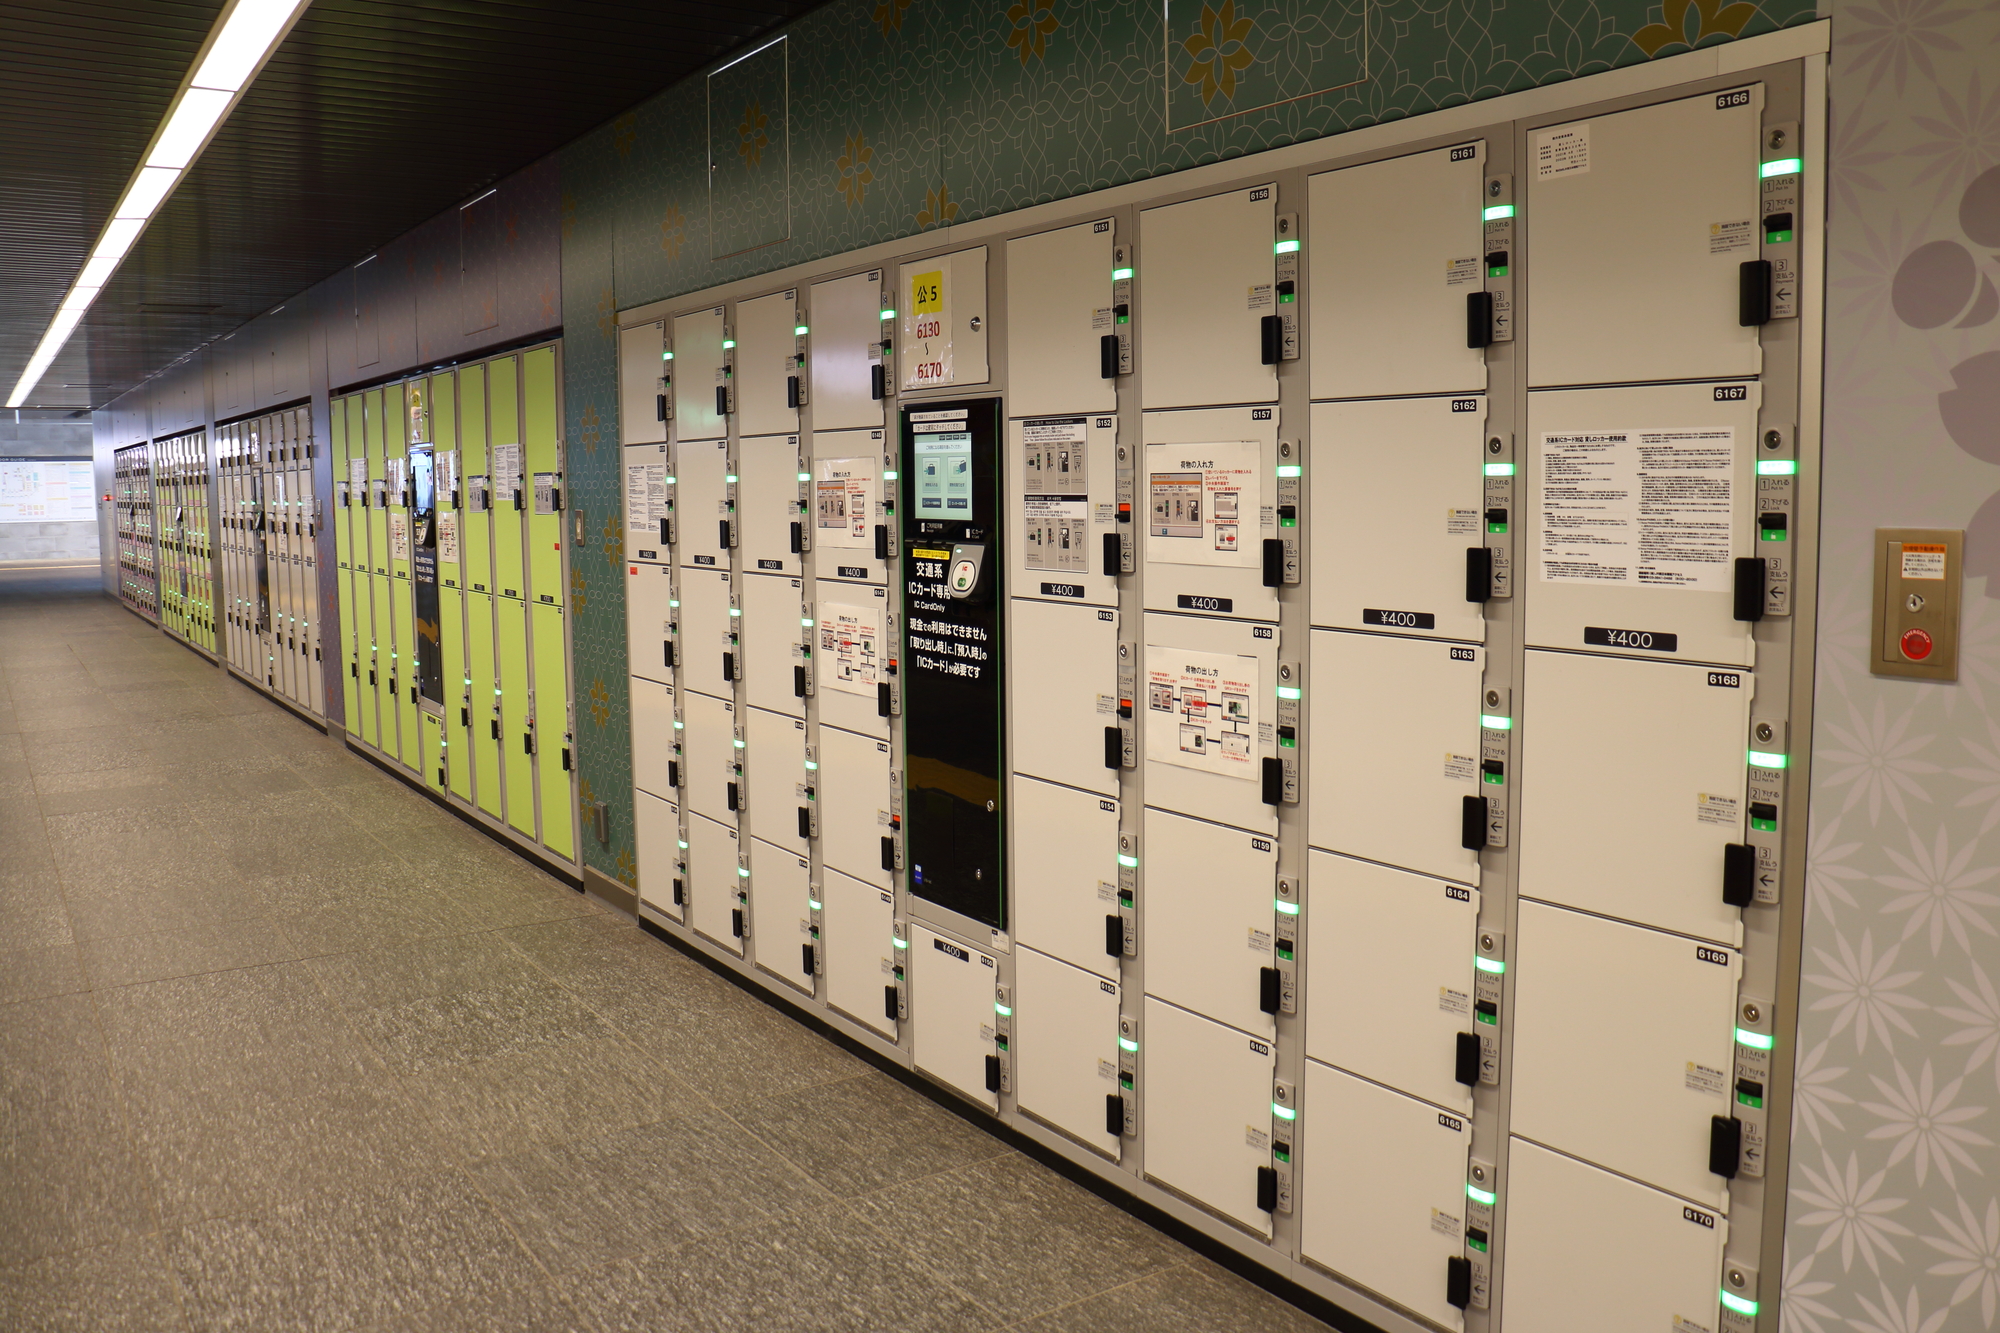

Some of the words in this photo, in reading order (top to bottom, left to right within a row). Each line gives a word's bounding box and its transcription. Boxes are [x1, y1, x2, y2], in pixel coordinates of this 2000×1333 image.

[1718, 92, 1748, 107] 6166
[1452, 148, 1473, 159] 6161
[1775, 178, 1795, 186] 入れる
[1250, 190, 1268, 200] 6156
[1094, 223, 1108, 232] 6151
[1776, 271, 1795, 279] 支払う
[917, 286, 928, 304] 公
[931, 286, 937, 301] 5
[917, 321, 940, 338] 6130
[917, 362, 942, 379] 6170
[1716, 388, 1744, 398] 6167
[1453, 402, 1475, 410] 6162
[1253, 411, 1270, 419] 6157
[1180, 460, 1214, 469] 荷物の入れ方
[845, 568, 860, 577] ¥400
[916, 562, 943, 578] 交通系
[908, 581, 950, 600] ICカード専用
[1051, 585, 1073, 596] ¥400
[1191, 597, 1218, 610] ¥400
[1098, 612, 1112, 621] 6153
[1381, 611, 1415, 626] ¥400
[909, 618, 987, 641] 現金での利用はできません
[1254, 629, 1271, 637] 6158
[1608, 630, 1652, 648] ¥400
[1904, 629, 1930, 643] EMERGENCY
[1452, 650, 1473, 659] 6163
[917, 655, 981, 679] 「ICカード」が必要です
[1185, 665, 1218, 677] 荷物の出し方
[1710, 674, 1738, 686] 6168
[1762, 770, 1780, 779] 入れる
[1761, 790, 1780, 799] 下げる
[1100, 802, 1114, 811] 6154
[1253, 840, 1270, 851] 6159
[1447, 888, 1468, 900] 6164
[943, 944, 960, 958] ¥400
[1698, 950, 1726, 963] 6169
[1250, 1041, 1268, 1055] 6160
[1749, 1050, 1766, 1059] 入れる
[1748, 1068, 1765, 1077] 下げる
[1440, 1116, 1460, 1130] 6165
[1685, 1209, 1712, 1225] 6170
